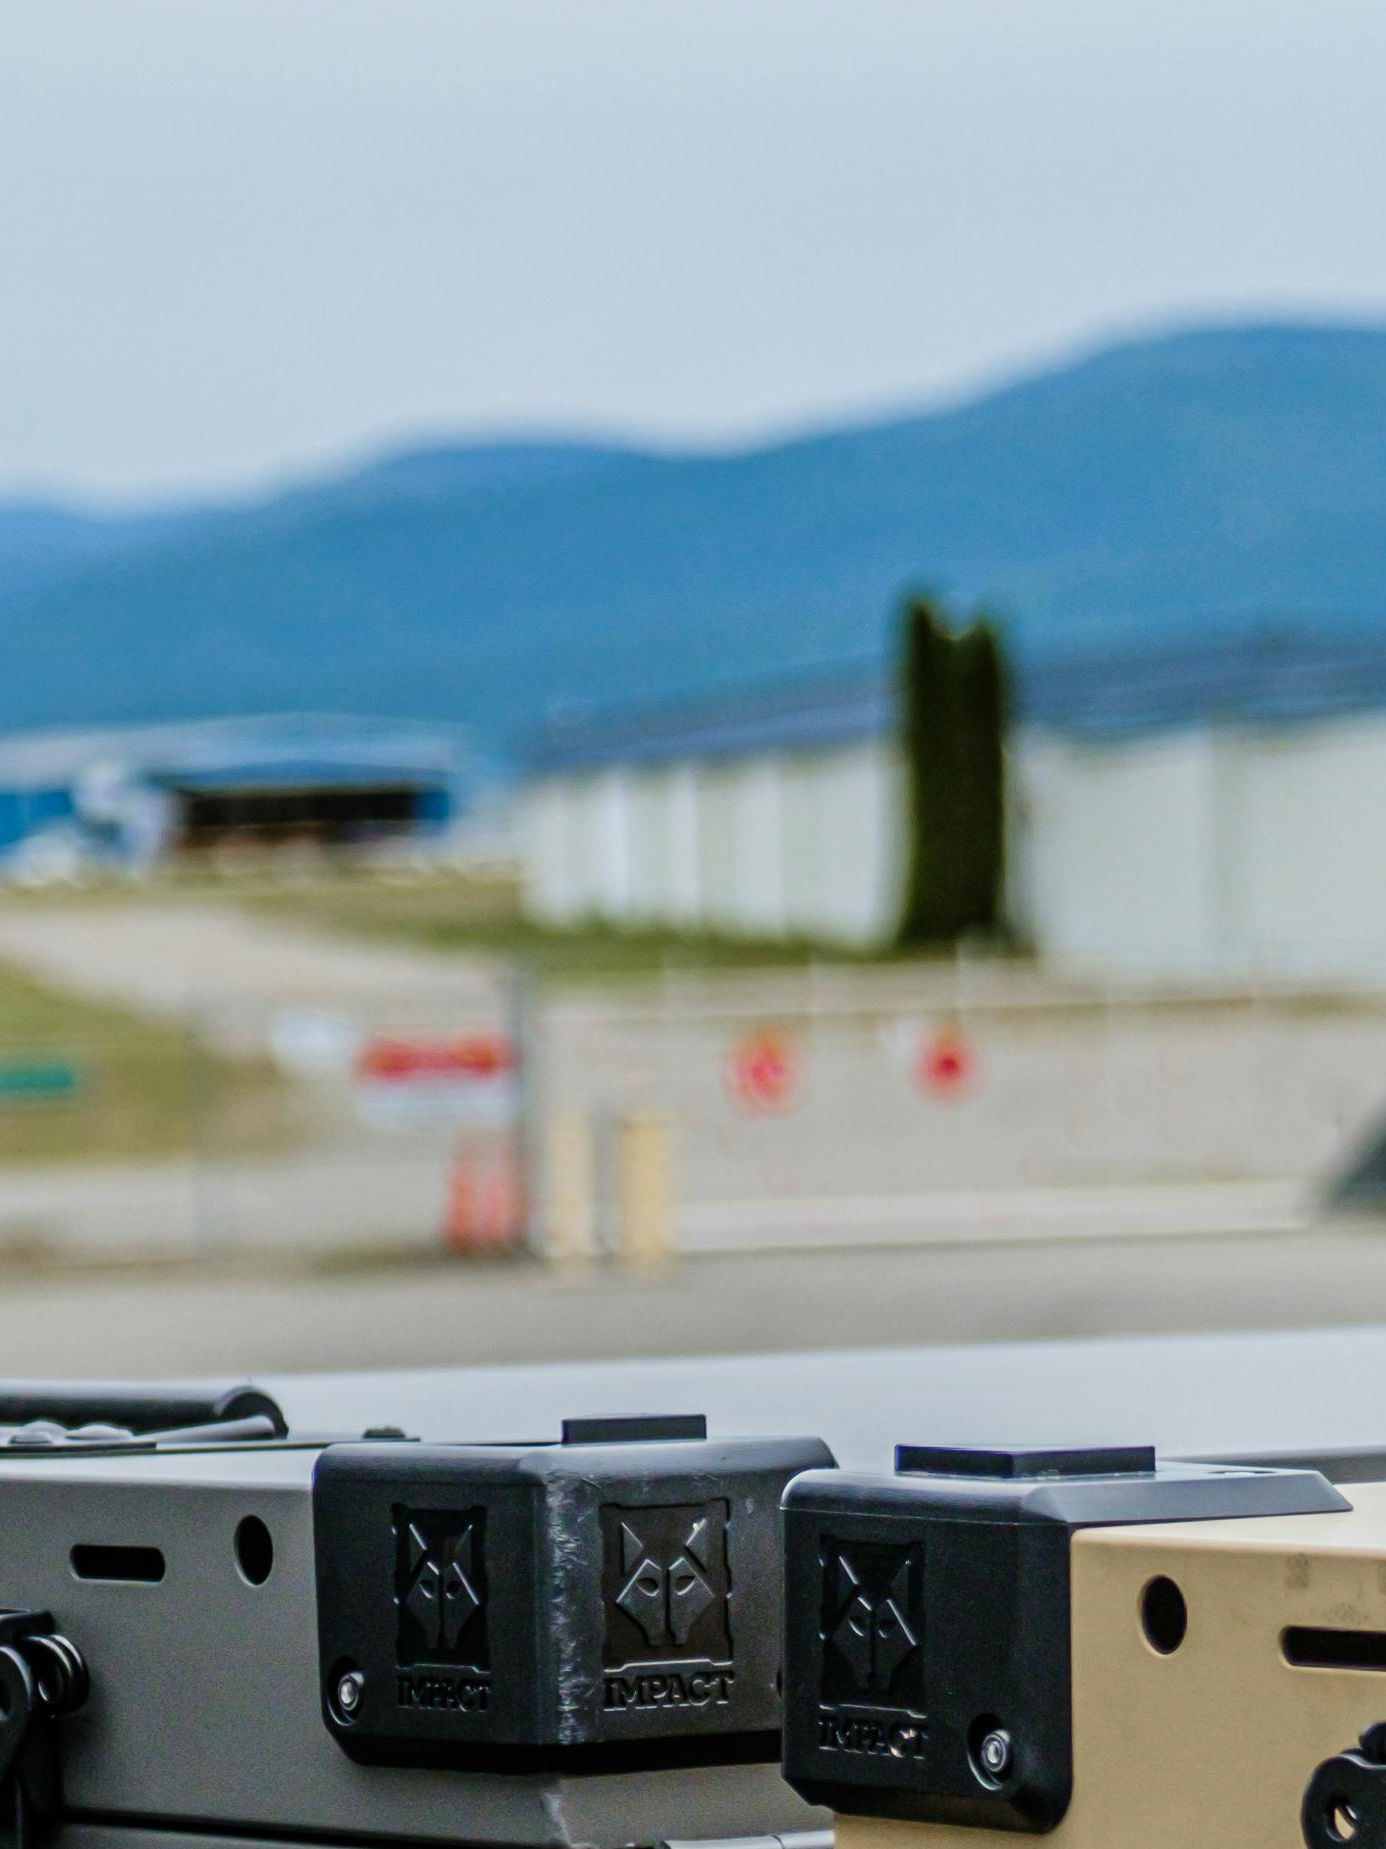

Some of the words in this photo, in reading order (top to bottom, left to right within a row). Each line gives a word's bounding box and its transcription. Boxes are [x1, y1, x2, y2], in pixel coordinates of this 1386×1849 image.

[396, 1676, 491, 1712] IMPACT
[602, 1670, 735, 1712] IMPACT
[818, 1716, 930, 1760] IMPACT
